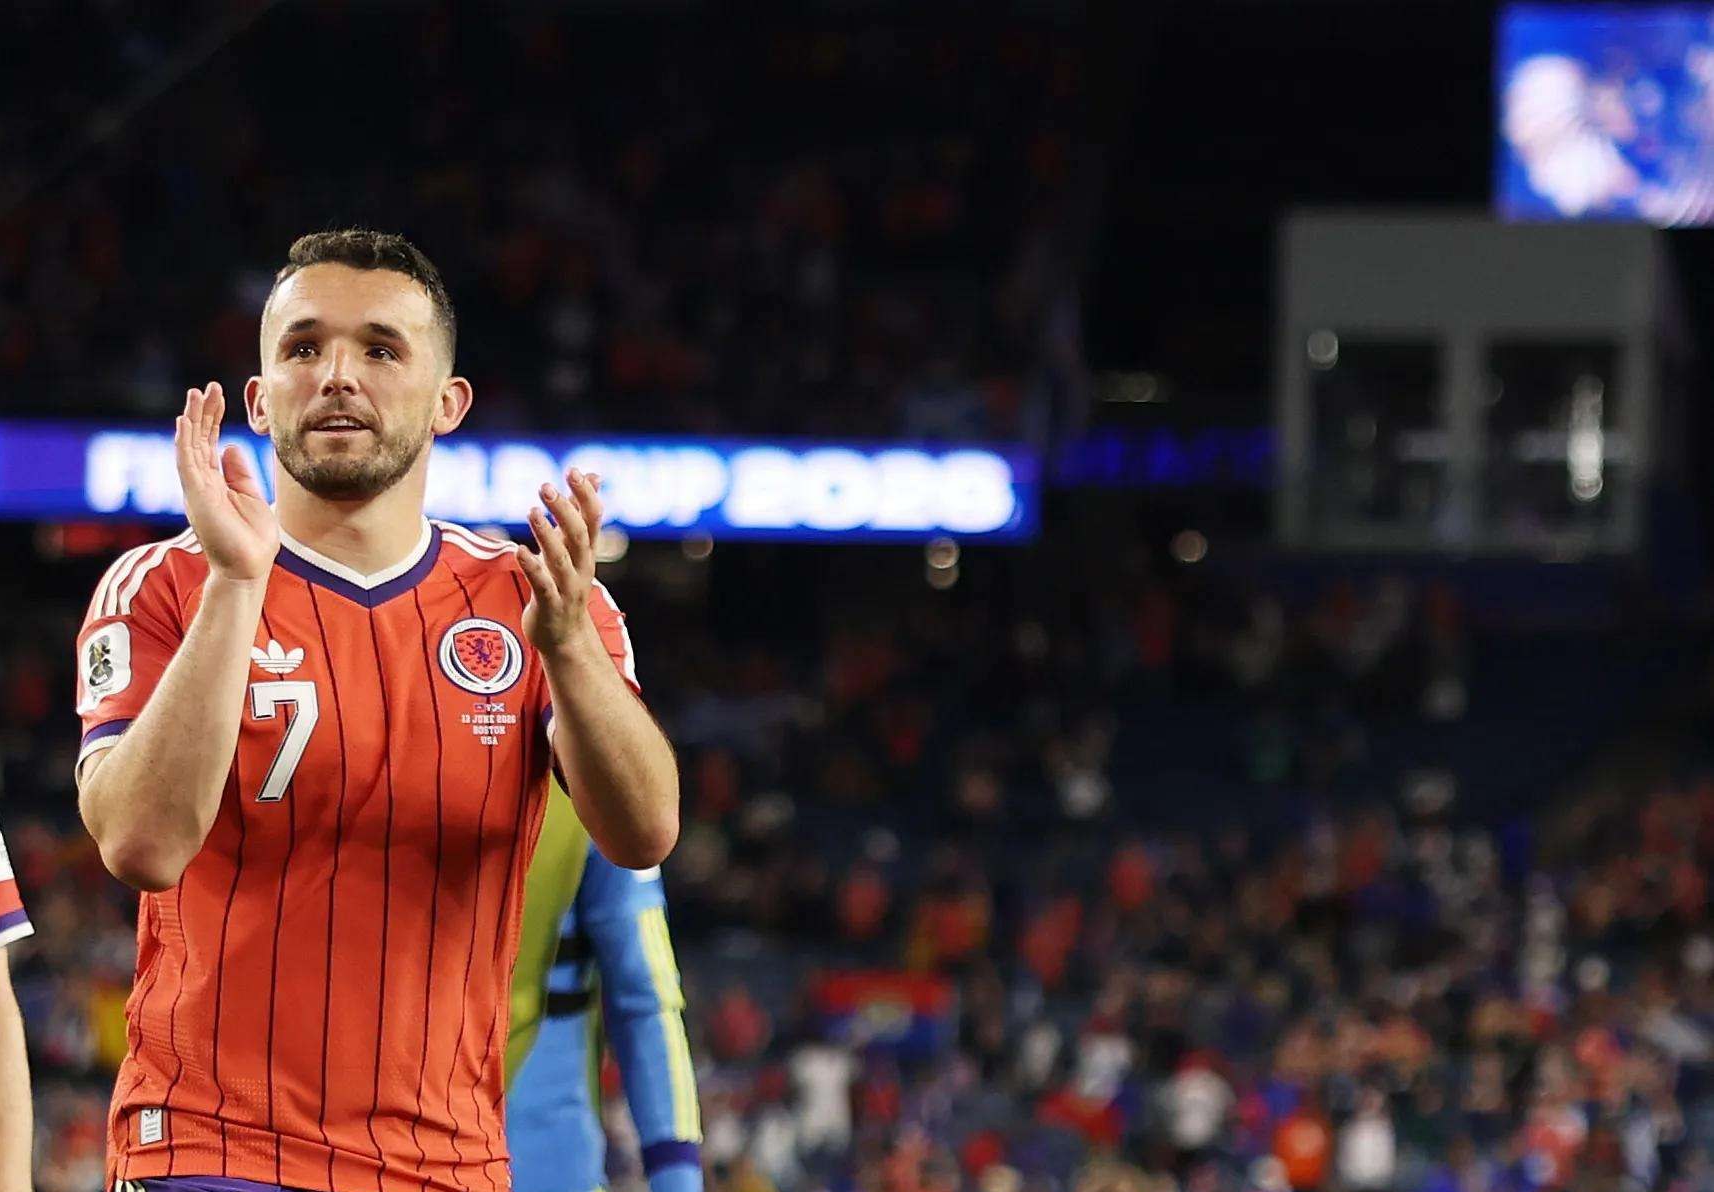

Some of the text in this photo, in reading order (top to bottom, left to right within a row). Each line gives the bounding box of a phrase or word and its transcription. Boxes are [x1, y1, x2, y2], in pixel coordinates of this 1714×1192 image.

[724, 446, 1017, 534] 2026
[252, 681, 318, 802] 7
[472, 725, 506, 735] BOSTON
[480, 736, 499, 745] USA
